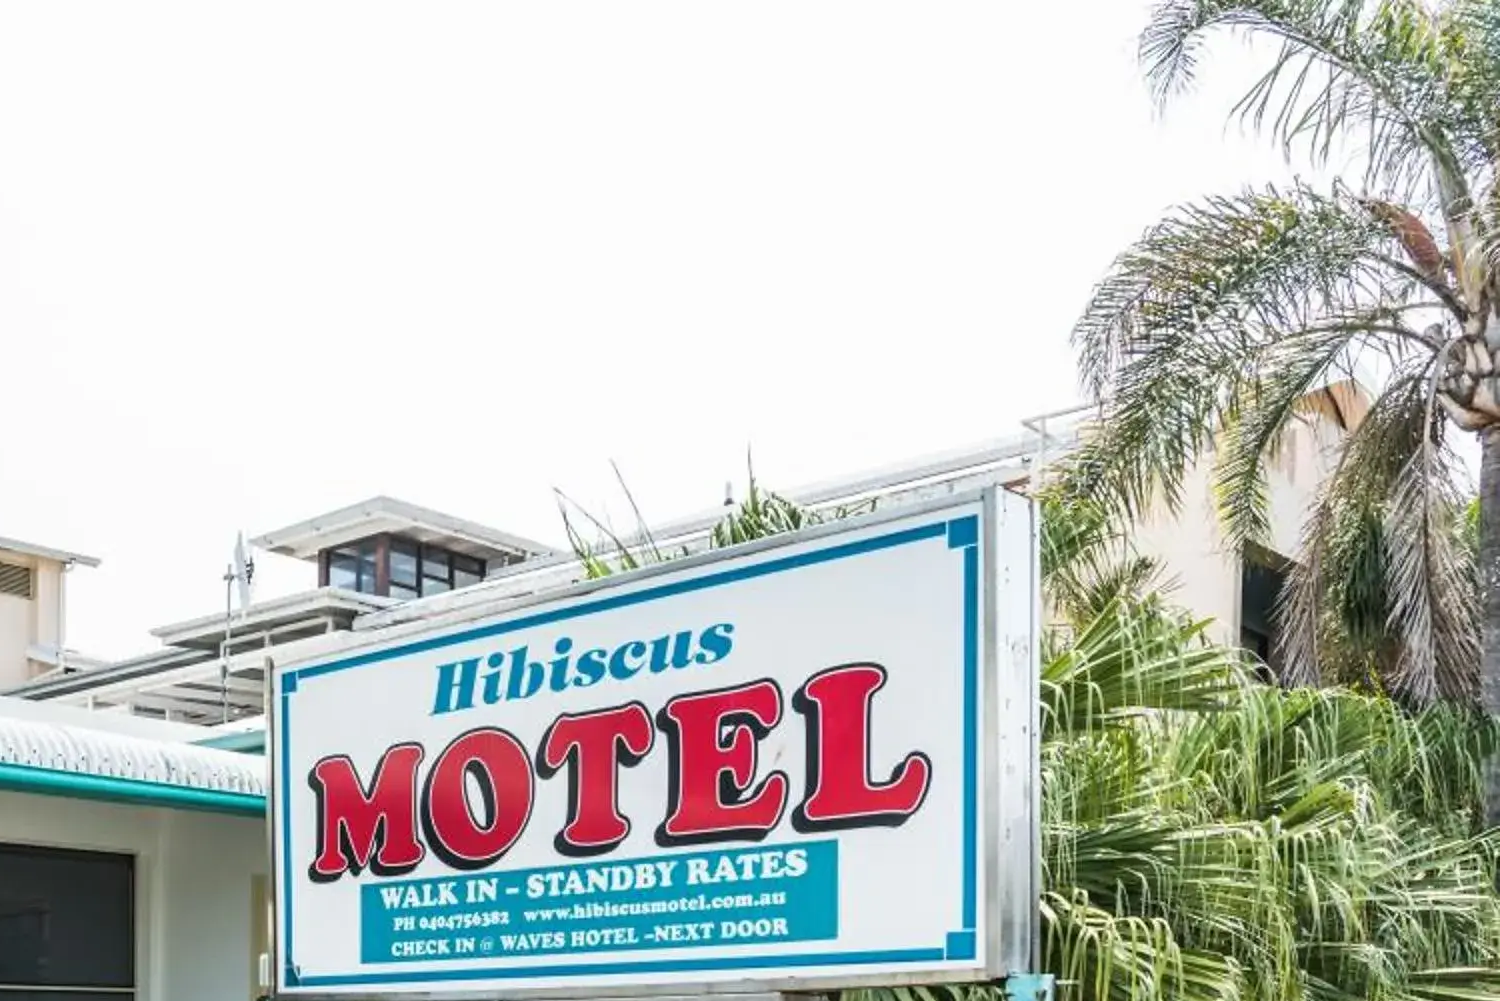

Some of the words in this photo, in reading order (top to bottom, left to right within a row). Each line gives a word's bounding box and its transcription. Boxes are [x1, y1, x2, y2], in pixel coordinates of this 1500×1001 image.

[430, 622, 735, 717] Hibiscus
[308, 661, 933, 884] MOTEL
[380, 881, 459, 909] WALK
[466, 878, 499, 903] IN
[526, 860, 679, 899] STANDBY
[687, 849, 809, 886] RATES
[390, 939, 451, 957] CHECK
[455, 937, 476, 953] IN
[479, 935, 495, 954] @
[499, 932, 566, 951] WAVES
[571, 927, 640, 947] HOTEL
[720, 917, 789, 939] DOOR
[393, 915, 416, 932] PH
[419, 911, 510, 931] 0404756382
[523, 891, 787, 922] www.hibiscusmotel.com.au
